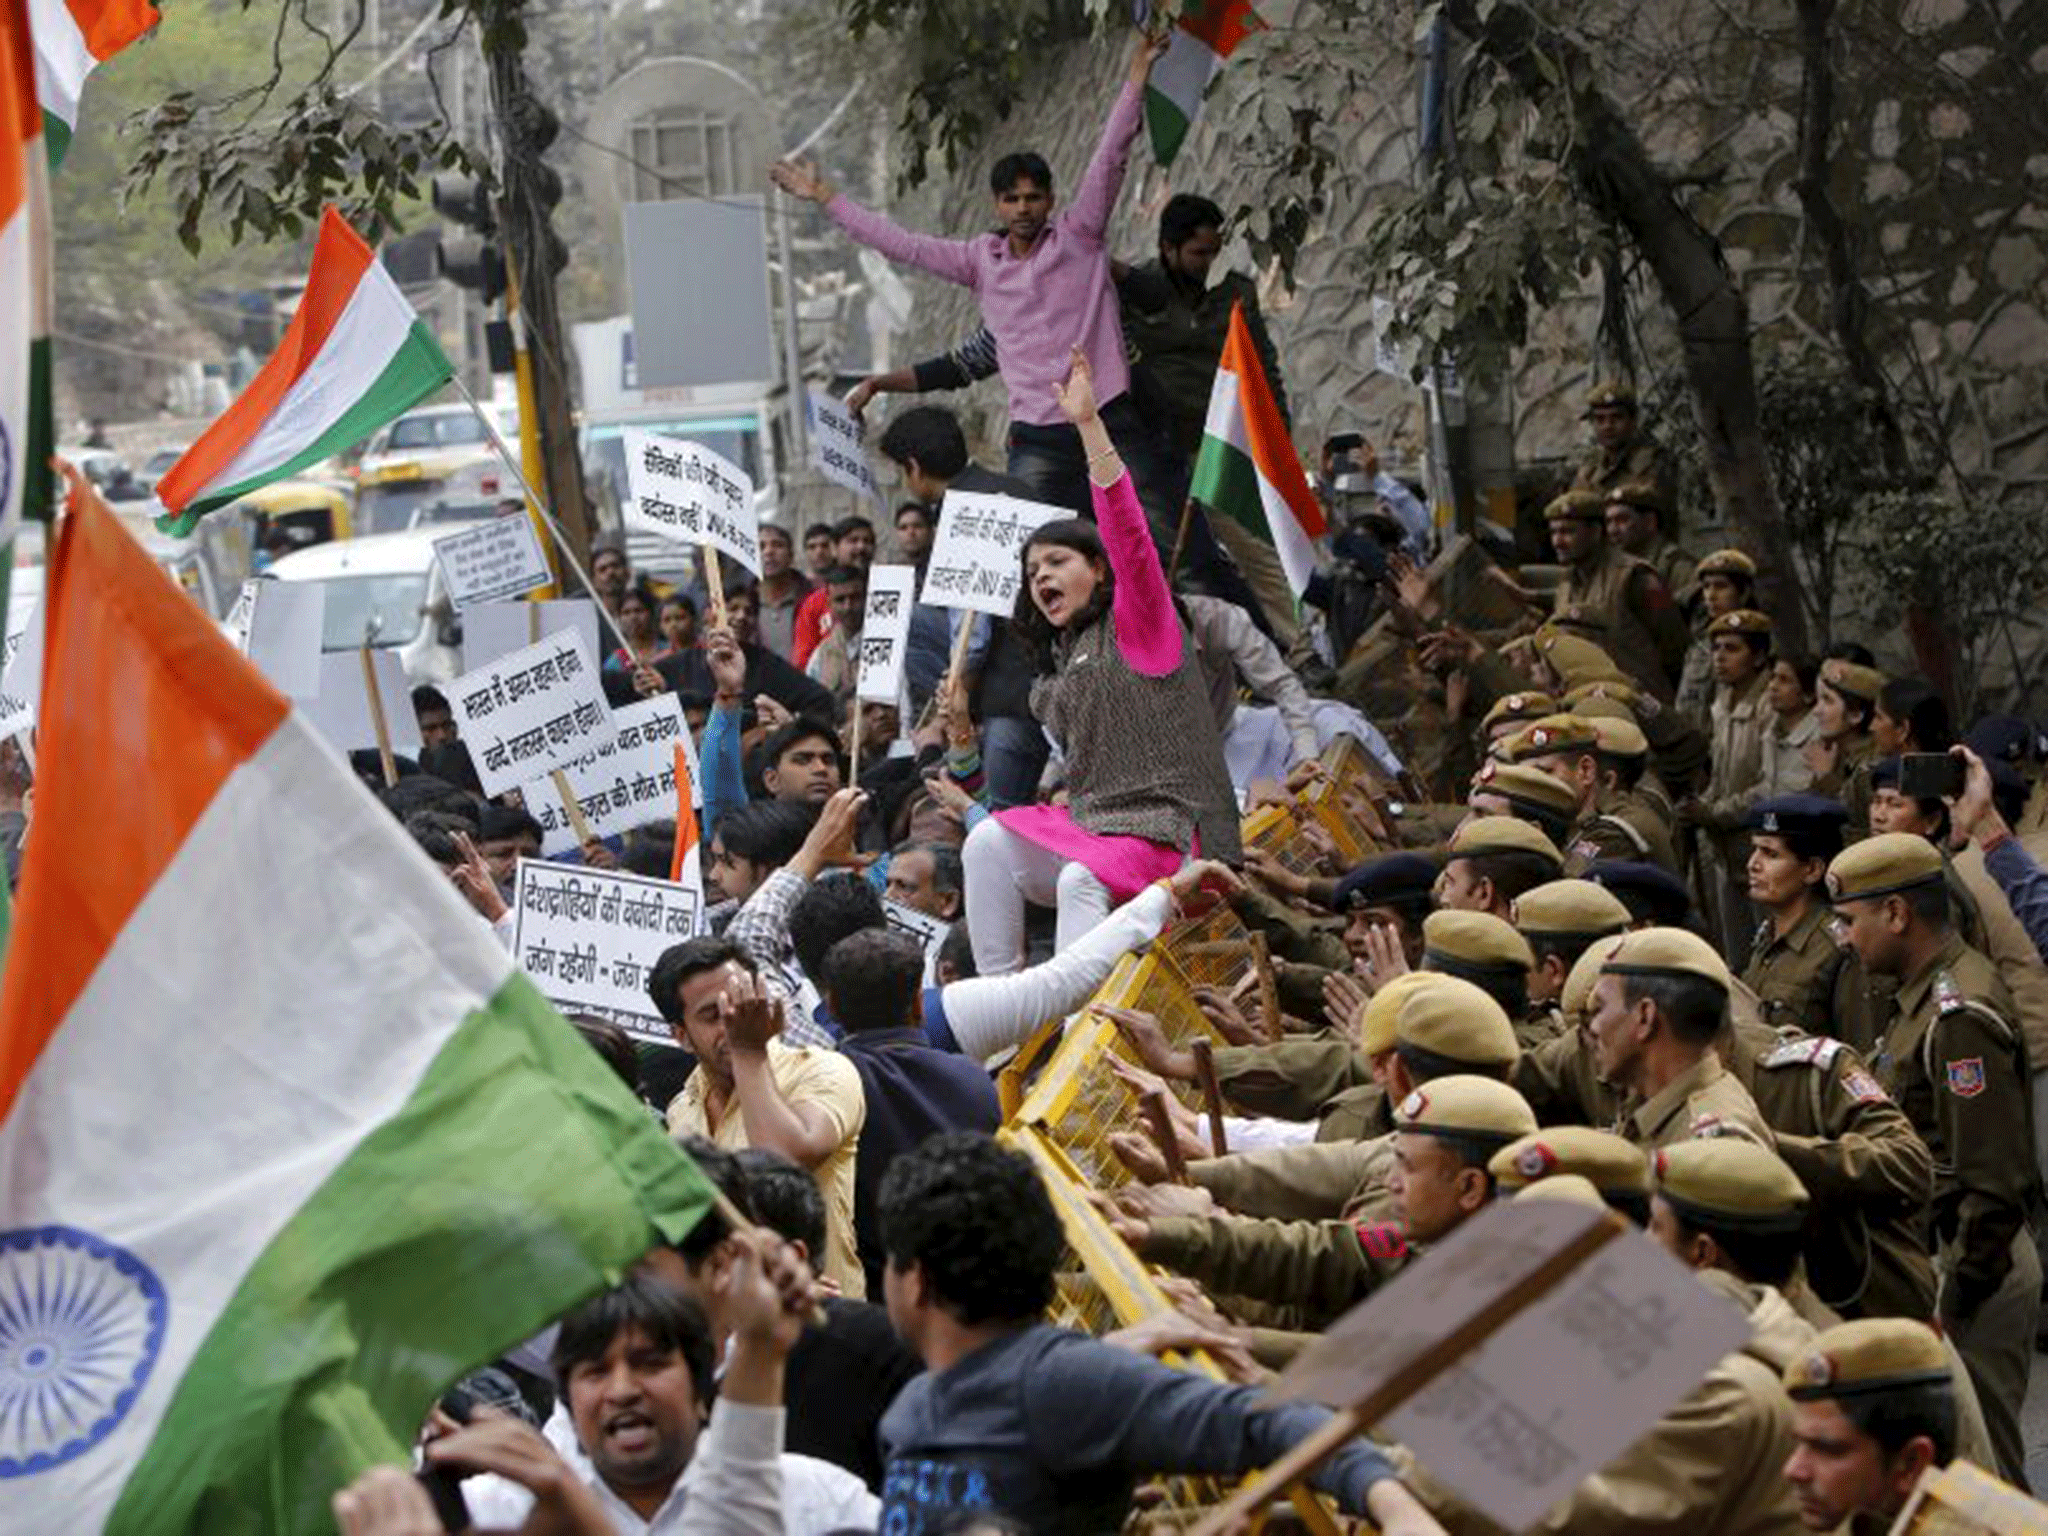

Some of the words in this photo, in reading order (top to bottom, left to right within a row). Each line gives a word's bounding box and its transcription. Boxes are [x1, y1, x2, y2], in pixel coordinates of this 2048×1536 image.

[462, 688, 495, 720] भारत
[491, 673, 508, 707] में
[609, 777, 632, 808] की
[524, 874, 602, 922] देशद्रोहियों
[600, 885, 623, 926] की
[666, 906, 693, 936] तक
[525, 937, 556, 977] जंग
[559, 943, 598, 984] रहेगी
[613, 952, 642, 992] जंग
